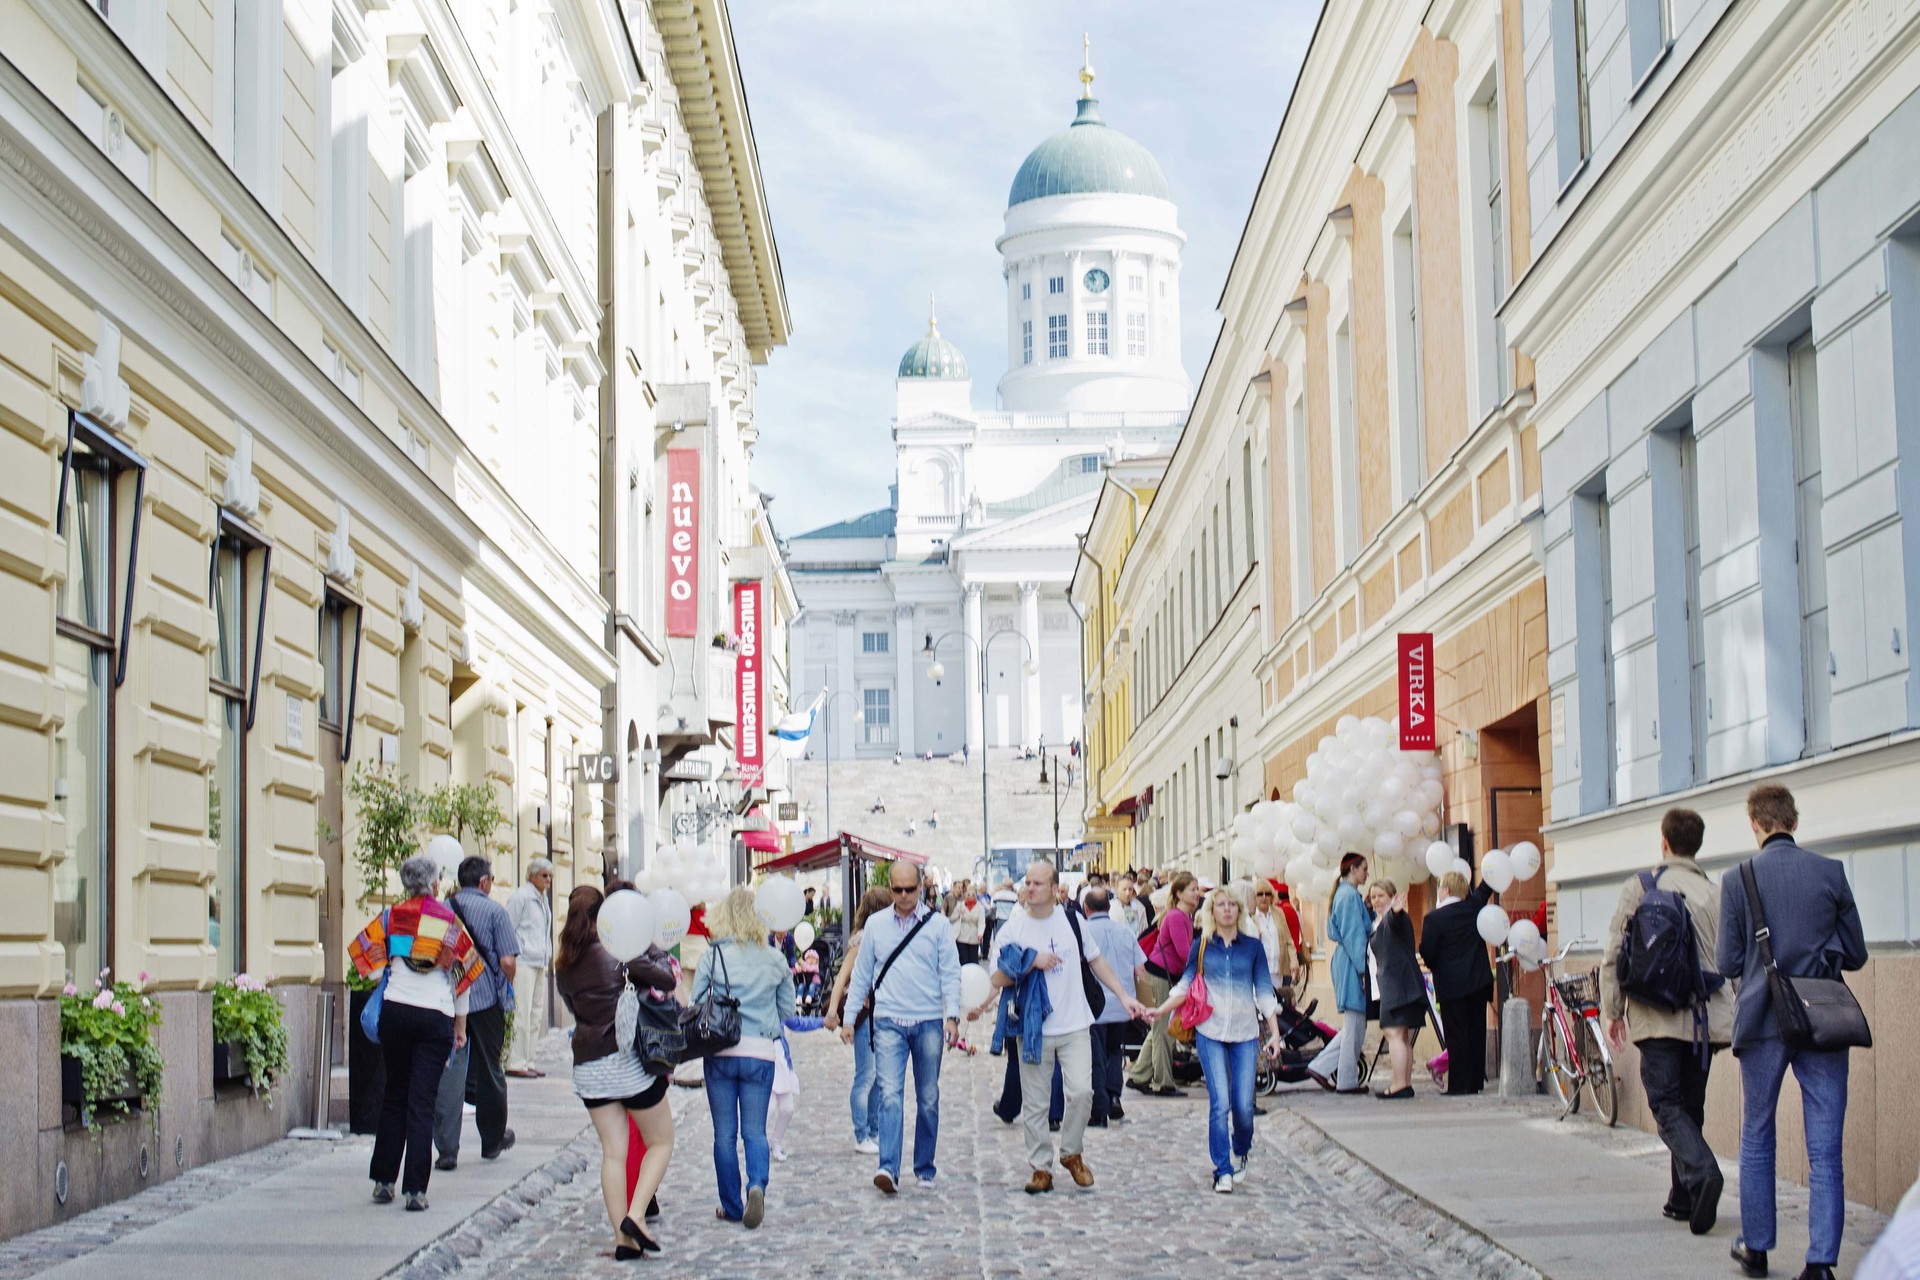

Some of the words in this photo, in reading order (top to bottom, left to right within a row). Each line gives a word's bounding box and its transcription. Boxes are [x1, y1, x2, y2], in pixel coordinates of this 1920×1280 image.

[671, 481, 694, 601] nuevo
[741, 589, 755, 657] museo
[742, 671, 756, 757] museum
[1408, 642, 1426, 729] VIRKA
[582, 755, 612, 781] WC
